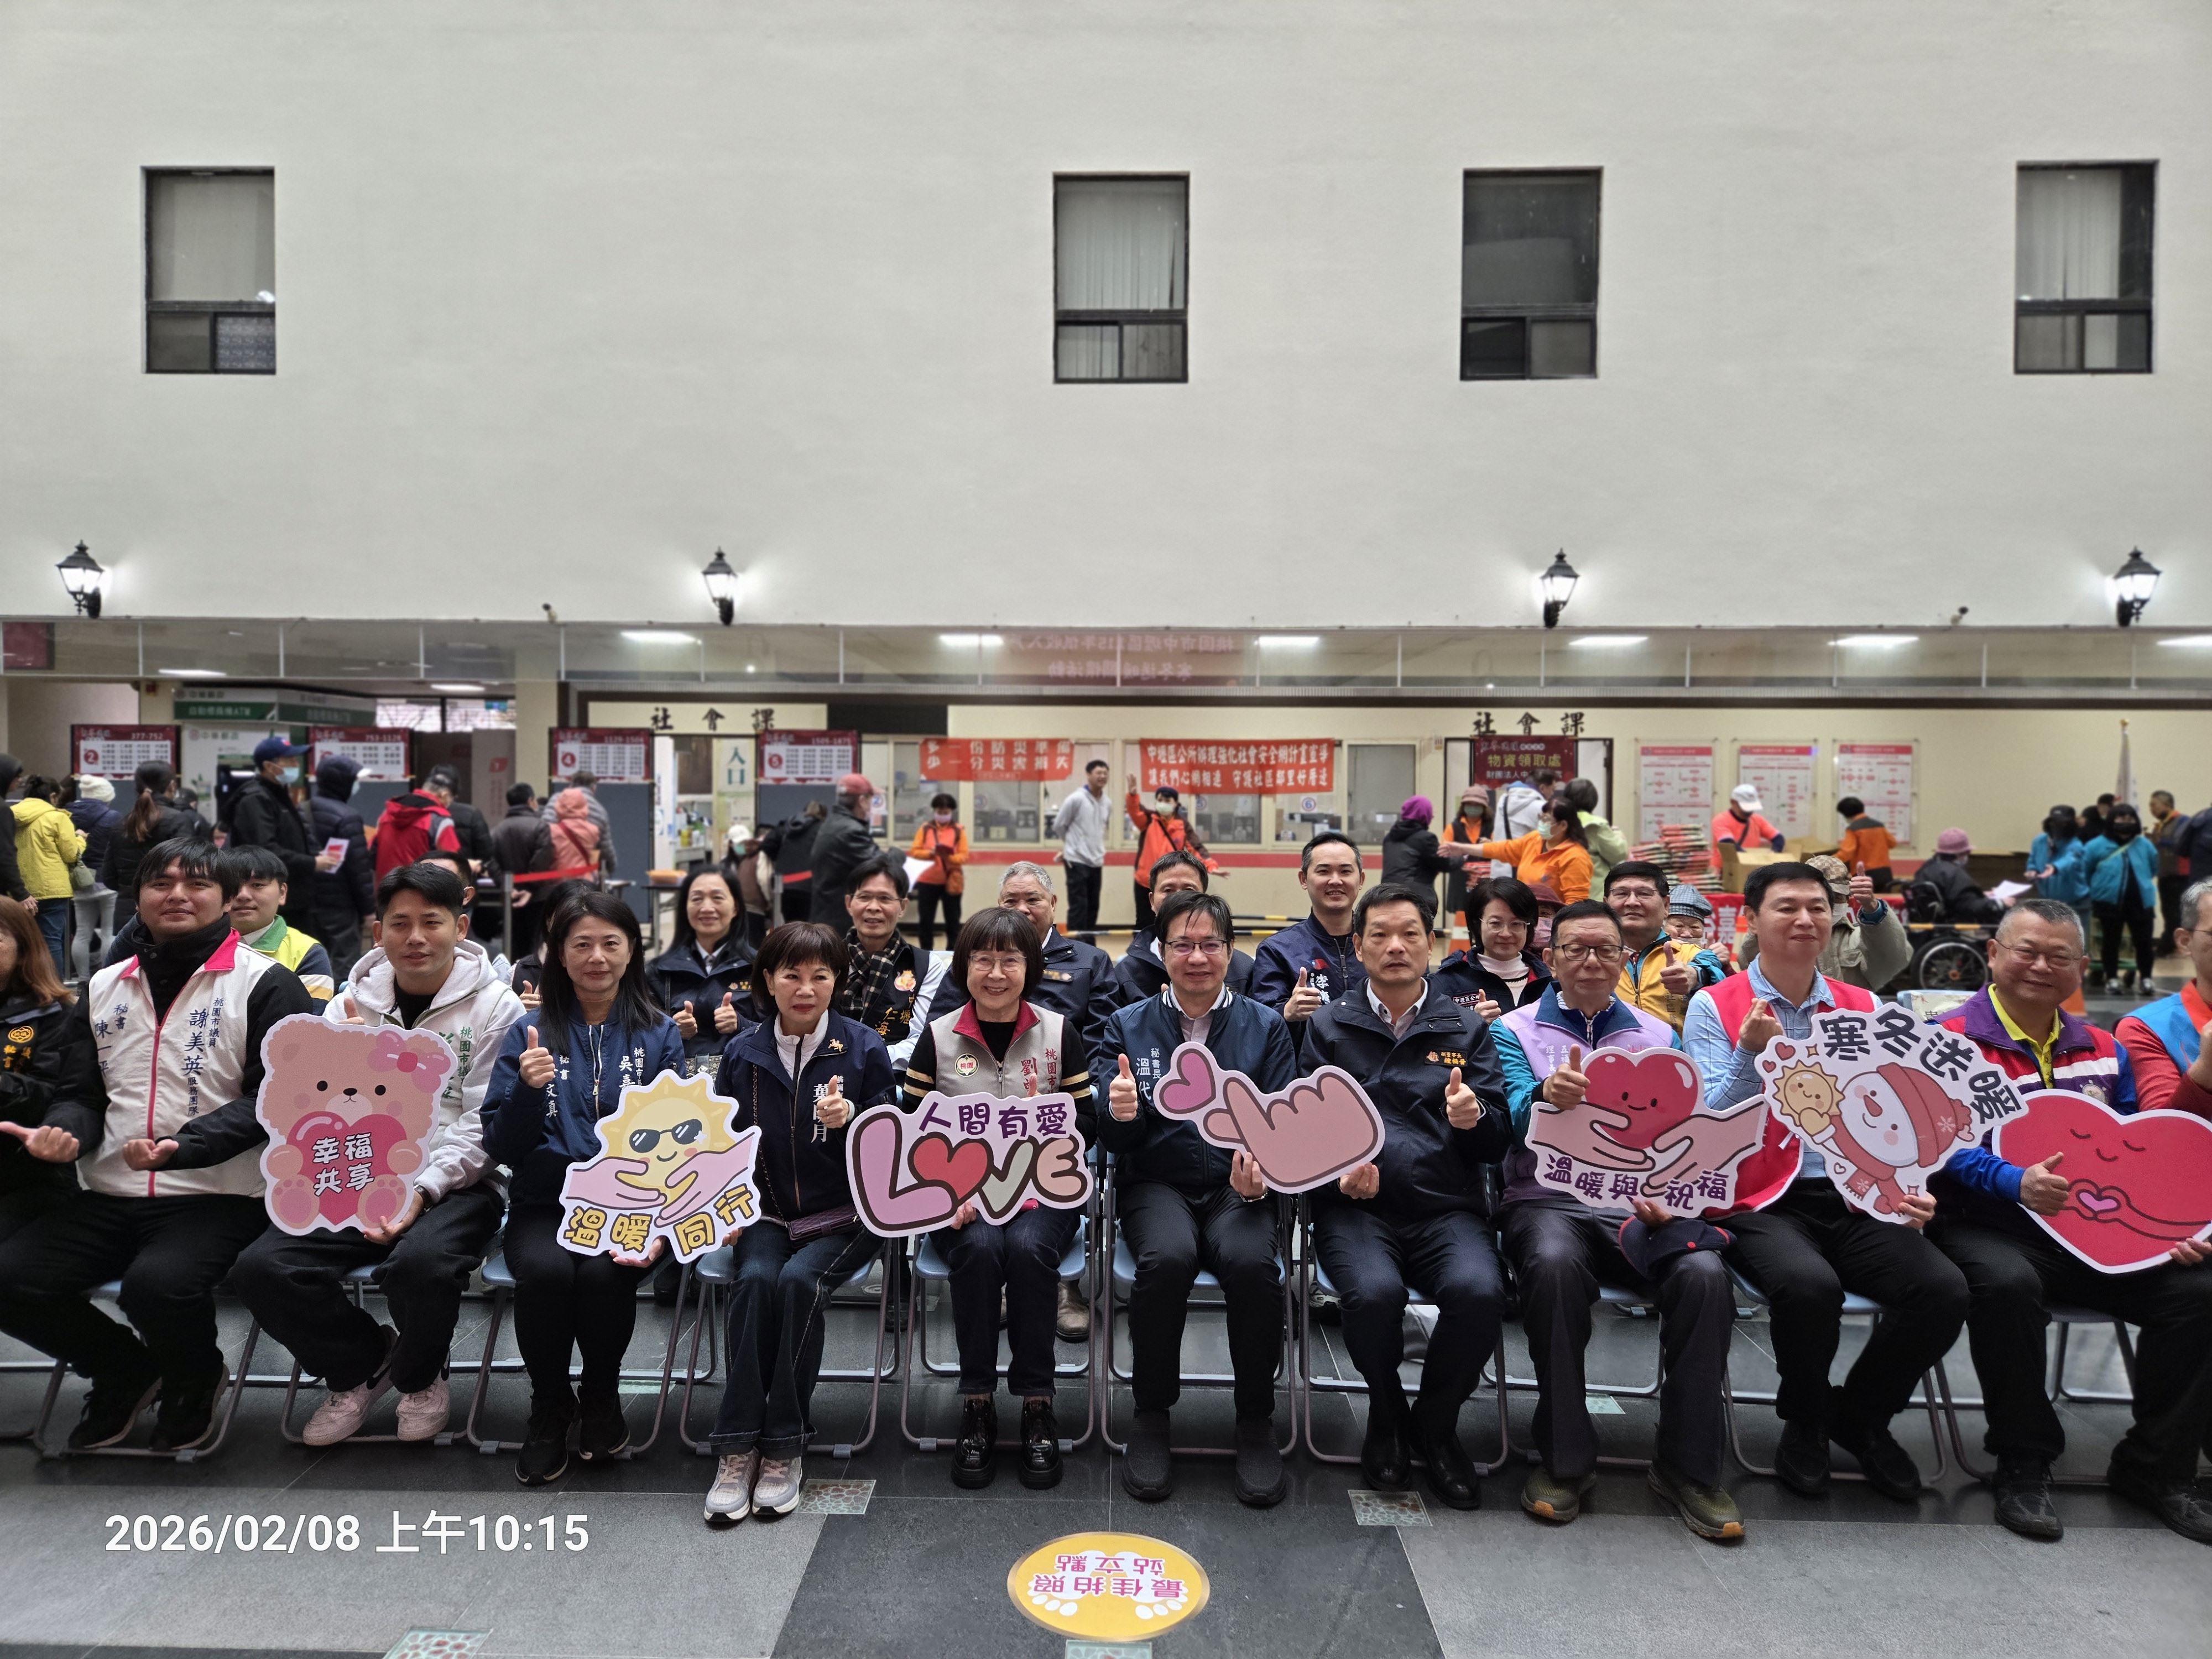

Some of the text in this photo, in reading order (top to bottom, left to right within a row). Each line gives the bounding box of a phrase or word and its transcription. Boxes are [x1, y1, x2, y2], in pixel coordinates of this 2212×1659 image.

[651, 707, 774, 731] 社會課
[1473, 712, 1584, 736] 社會課
[87, 752, 95, 761] 2
[727, 747, 745, 785] 入口
[1487, 754, 1561, 768] 物資領取處
[113, 1003, 128, 1029] 秘書
[208, 998, 224, 1047] 桃園市議員
[95, 1020, 113, 1078] 陳一平
[181, 1008, 209, 1076] 謝美英
[458, 1026, 472, 1084] 桃園市議
[560, 1055, 570, 1080] 秘書
[1045, 1048, 1058, 1093] 桃園市
[1151, 1048, 1161, 1079] 秘書長
[1819, 1008, 2022, 1124] 寒冬送暖
[187, 1077, 199, 1115] 服務團隊
[811, 1083, 828, 1144] 葉月
[919, 1102, 1068, 1139] 人間有愛
[312, 1132, 374, 1164] 幸福
[314, 1162, 374, 1197] 共享
[1545, 1154, 1729, 1210] 溫暖與祝福
[565, 1182, 754, 1256] 溫暖同行
[1057, 1555, 1162, 1575] 站立點
[1034, 1574, 1182, 1598] 最佳拍照
